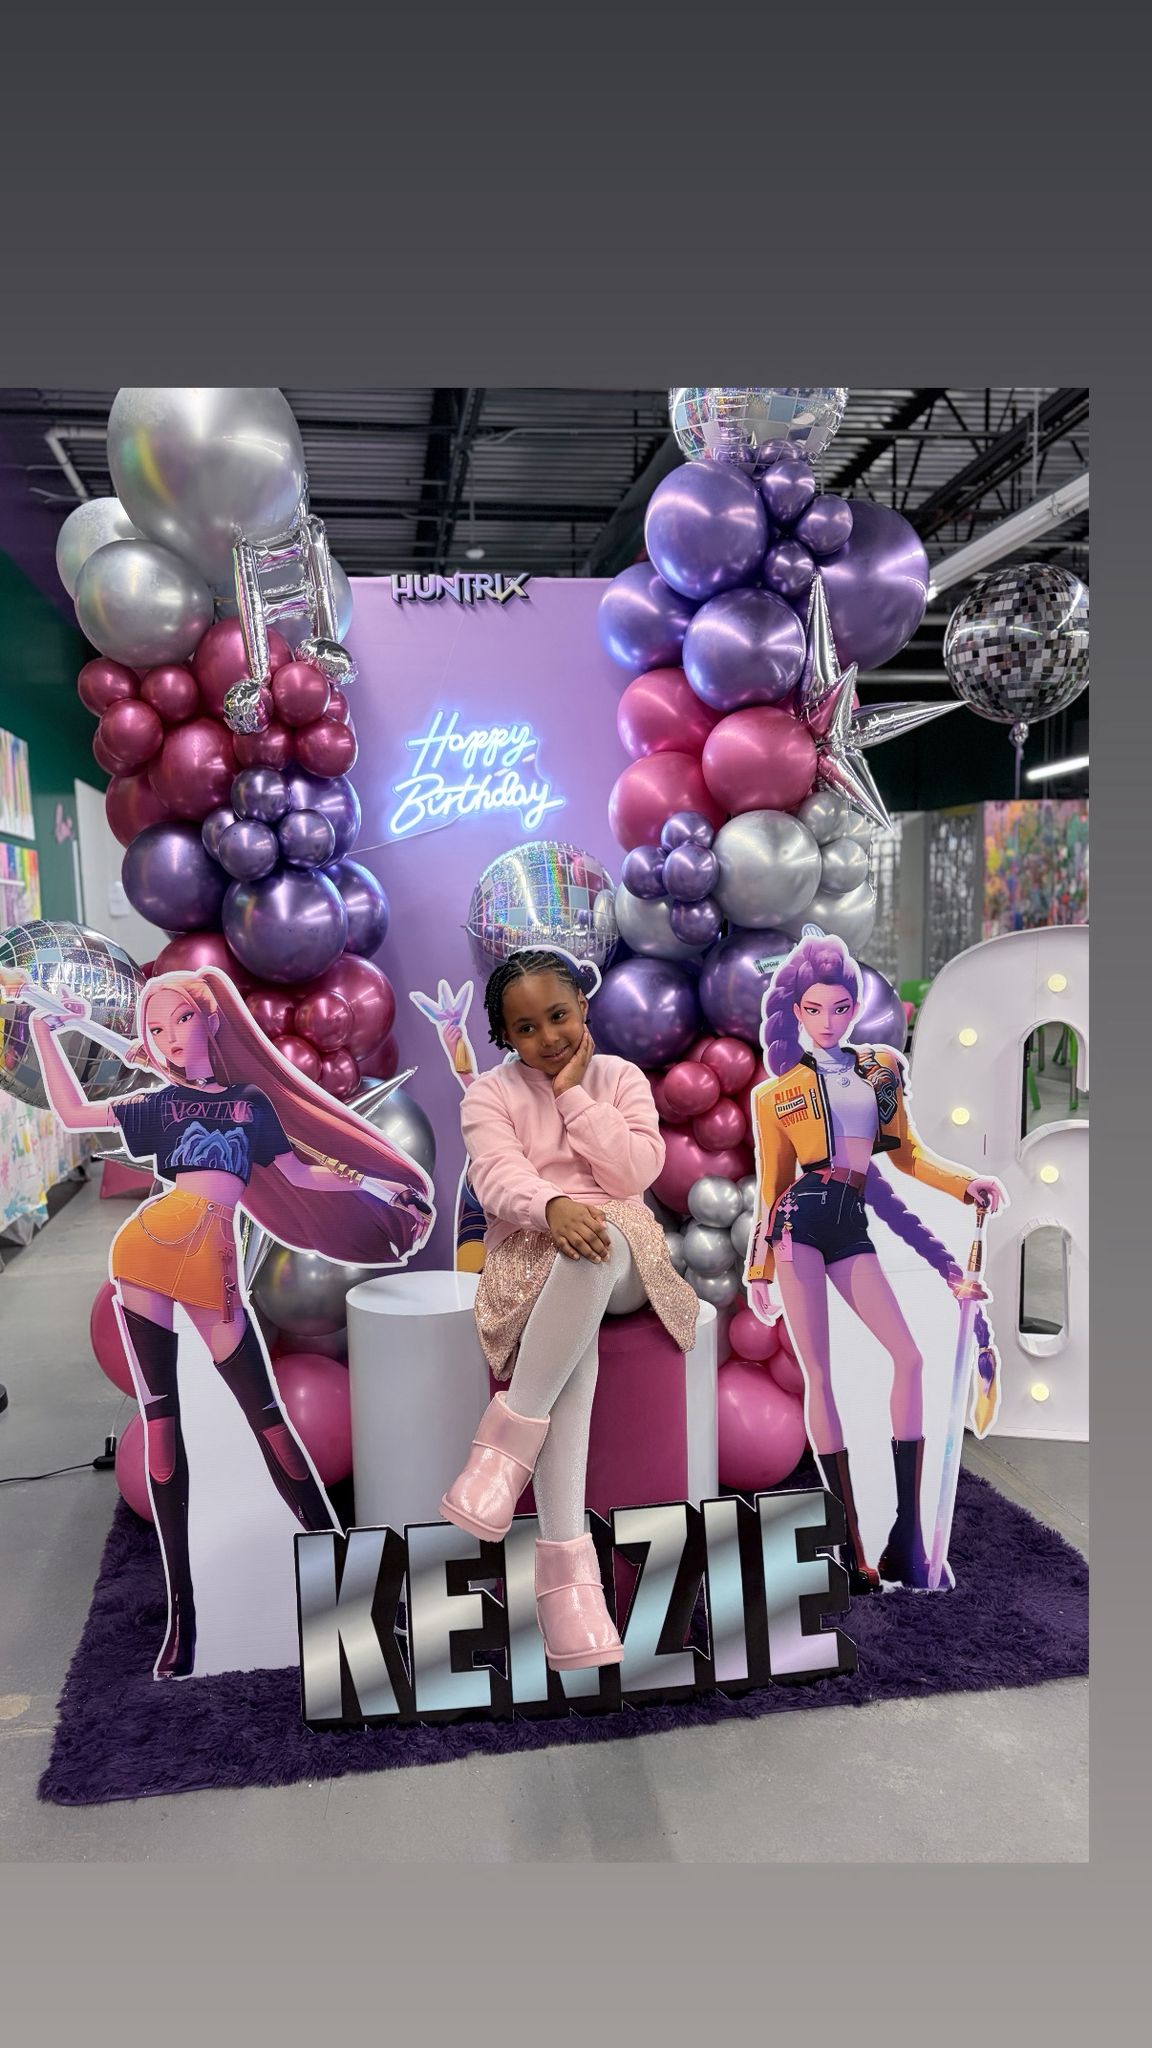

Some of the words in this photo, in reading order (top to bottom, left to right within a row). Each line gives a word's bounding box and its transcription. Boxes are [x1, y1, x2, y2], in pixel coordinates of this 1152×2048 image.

[391, 572, 530, 605] HUNTRIX
[408, 711, 537, 776] Happy
[390, 772, 564, 835] Birthday
